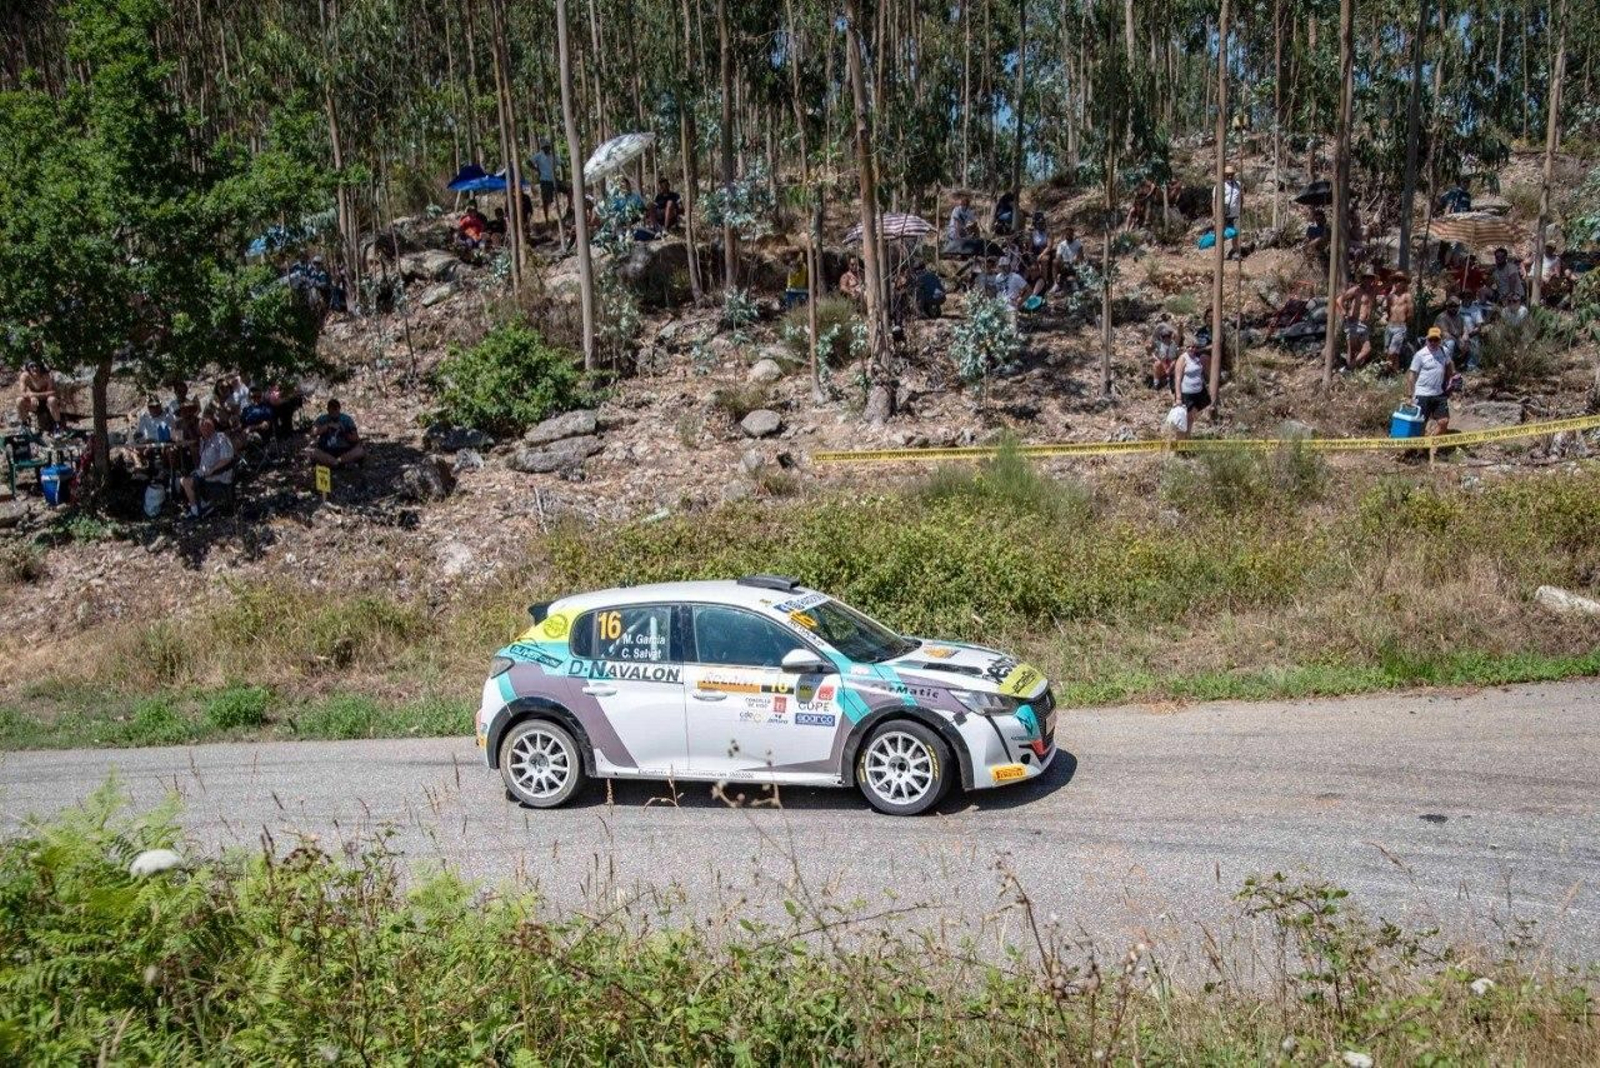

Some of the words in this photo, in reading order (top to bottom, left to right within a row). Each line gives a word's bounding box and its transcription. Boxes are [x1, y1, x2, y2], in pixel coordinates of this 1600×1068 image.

[1431, 436, 1448, 445] ZONA
[1483, 430, 1501, 440] ZONA
[1535, 423, 1552, 433] ZONA
[598, 611, 622, 640] 16
[623, 634, 634, 645] M.
[621, 648, 630, 658] C.
[797, 713, 835, 725] sparco
